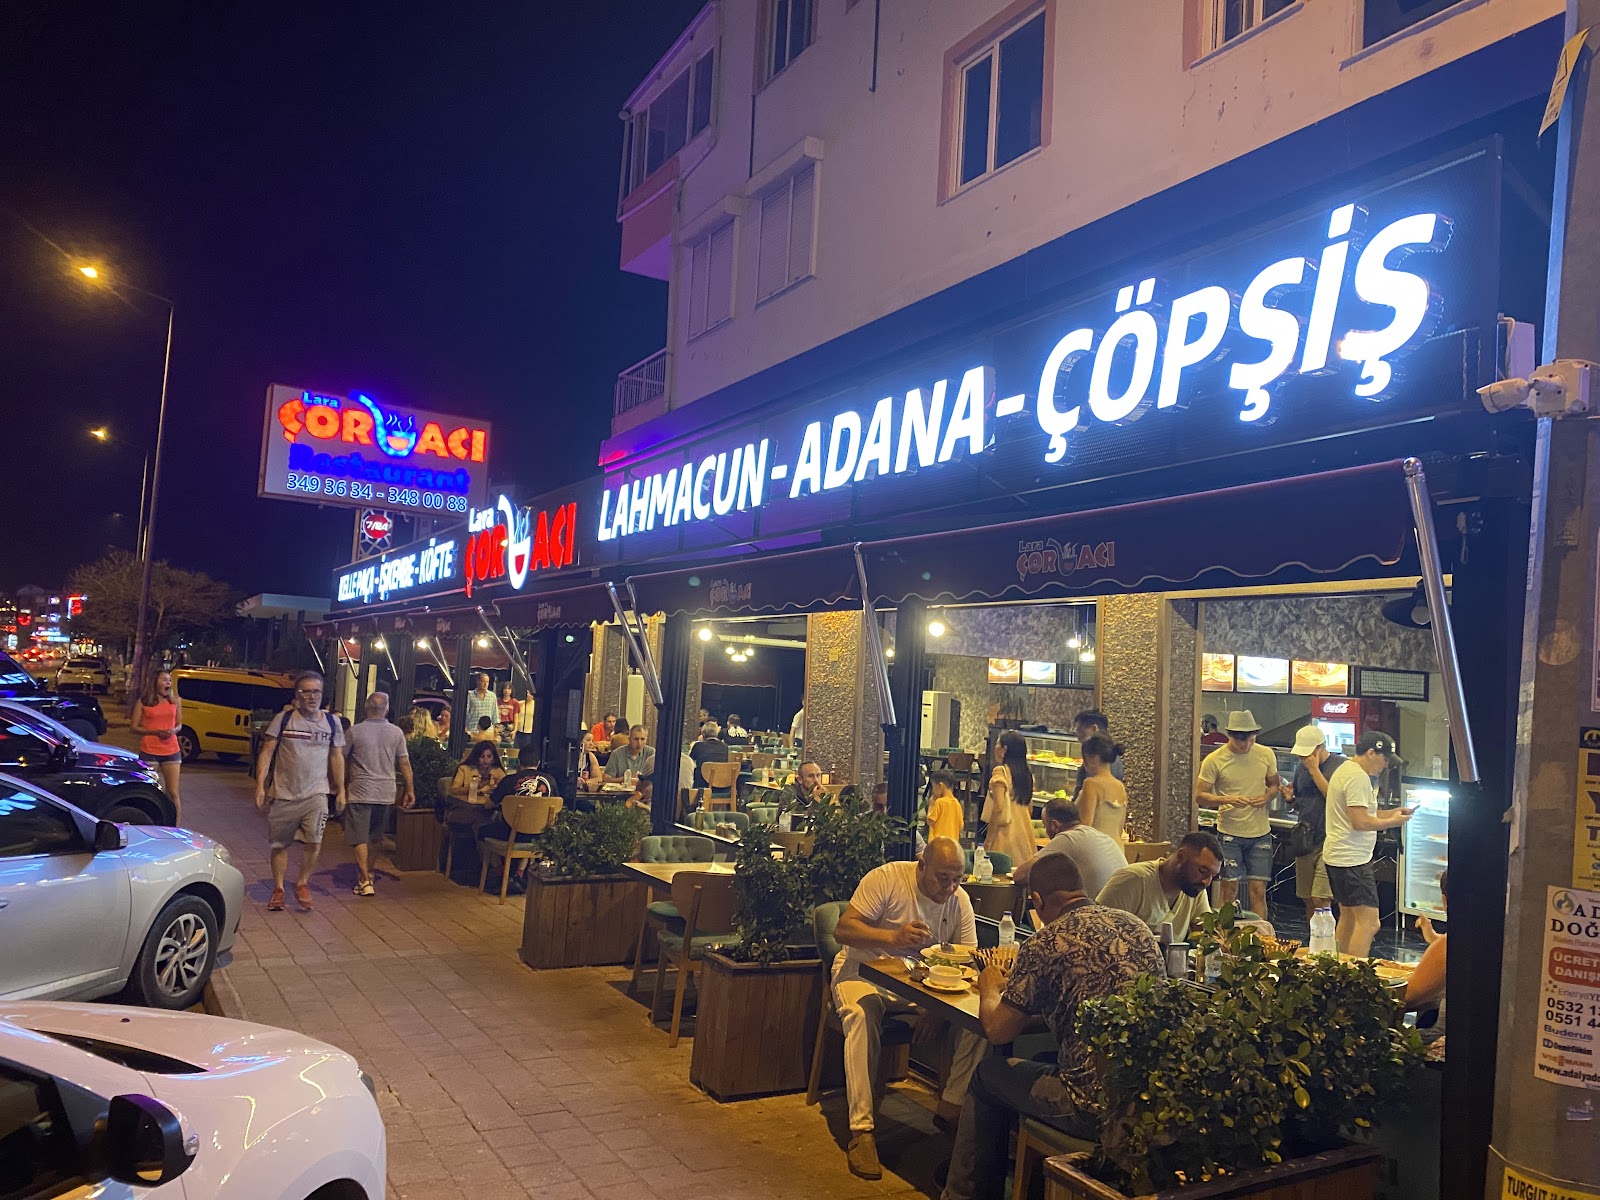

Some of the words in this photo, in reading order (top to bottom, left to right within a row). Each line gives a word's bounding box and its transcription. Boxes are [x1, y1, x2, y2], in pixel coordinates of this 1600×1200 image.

[598, 438, 769, 541] LAHMACUN
[789, 366, 984, 499] ADANA
[1037, 203, 1437, 464] ÇÖPŞİŞ
[303, 391, 340, 408] Lara
[289, 443, 469, 495] Restaurant
[287, 473, 320, 492] 349
[325, 478, 347, 495] 36
[350, 482, 372, 500] 34
[388, 487, 419, 505] 348
[422, 493, 443, 509] 00
[447, 497, 467, 512] 88
[468, 507, 495, 533] Lara
[1019, 541, 1044, 553] Lara
[1554, 966, 1600, 983] DANIŞ
[1547, 997, 1584, 1014] 0532
[1546, 1010, 1581, 1027] 0551
[1544, 1024, 1593, 1041] Buderus
